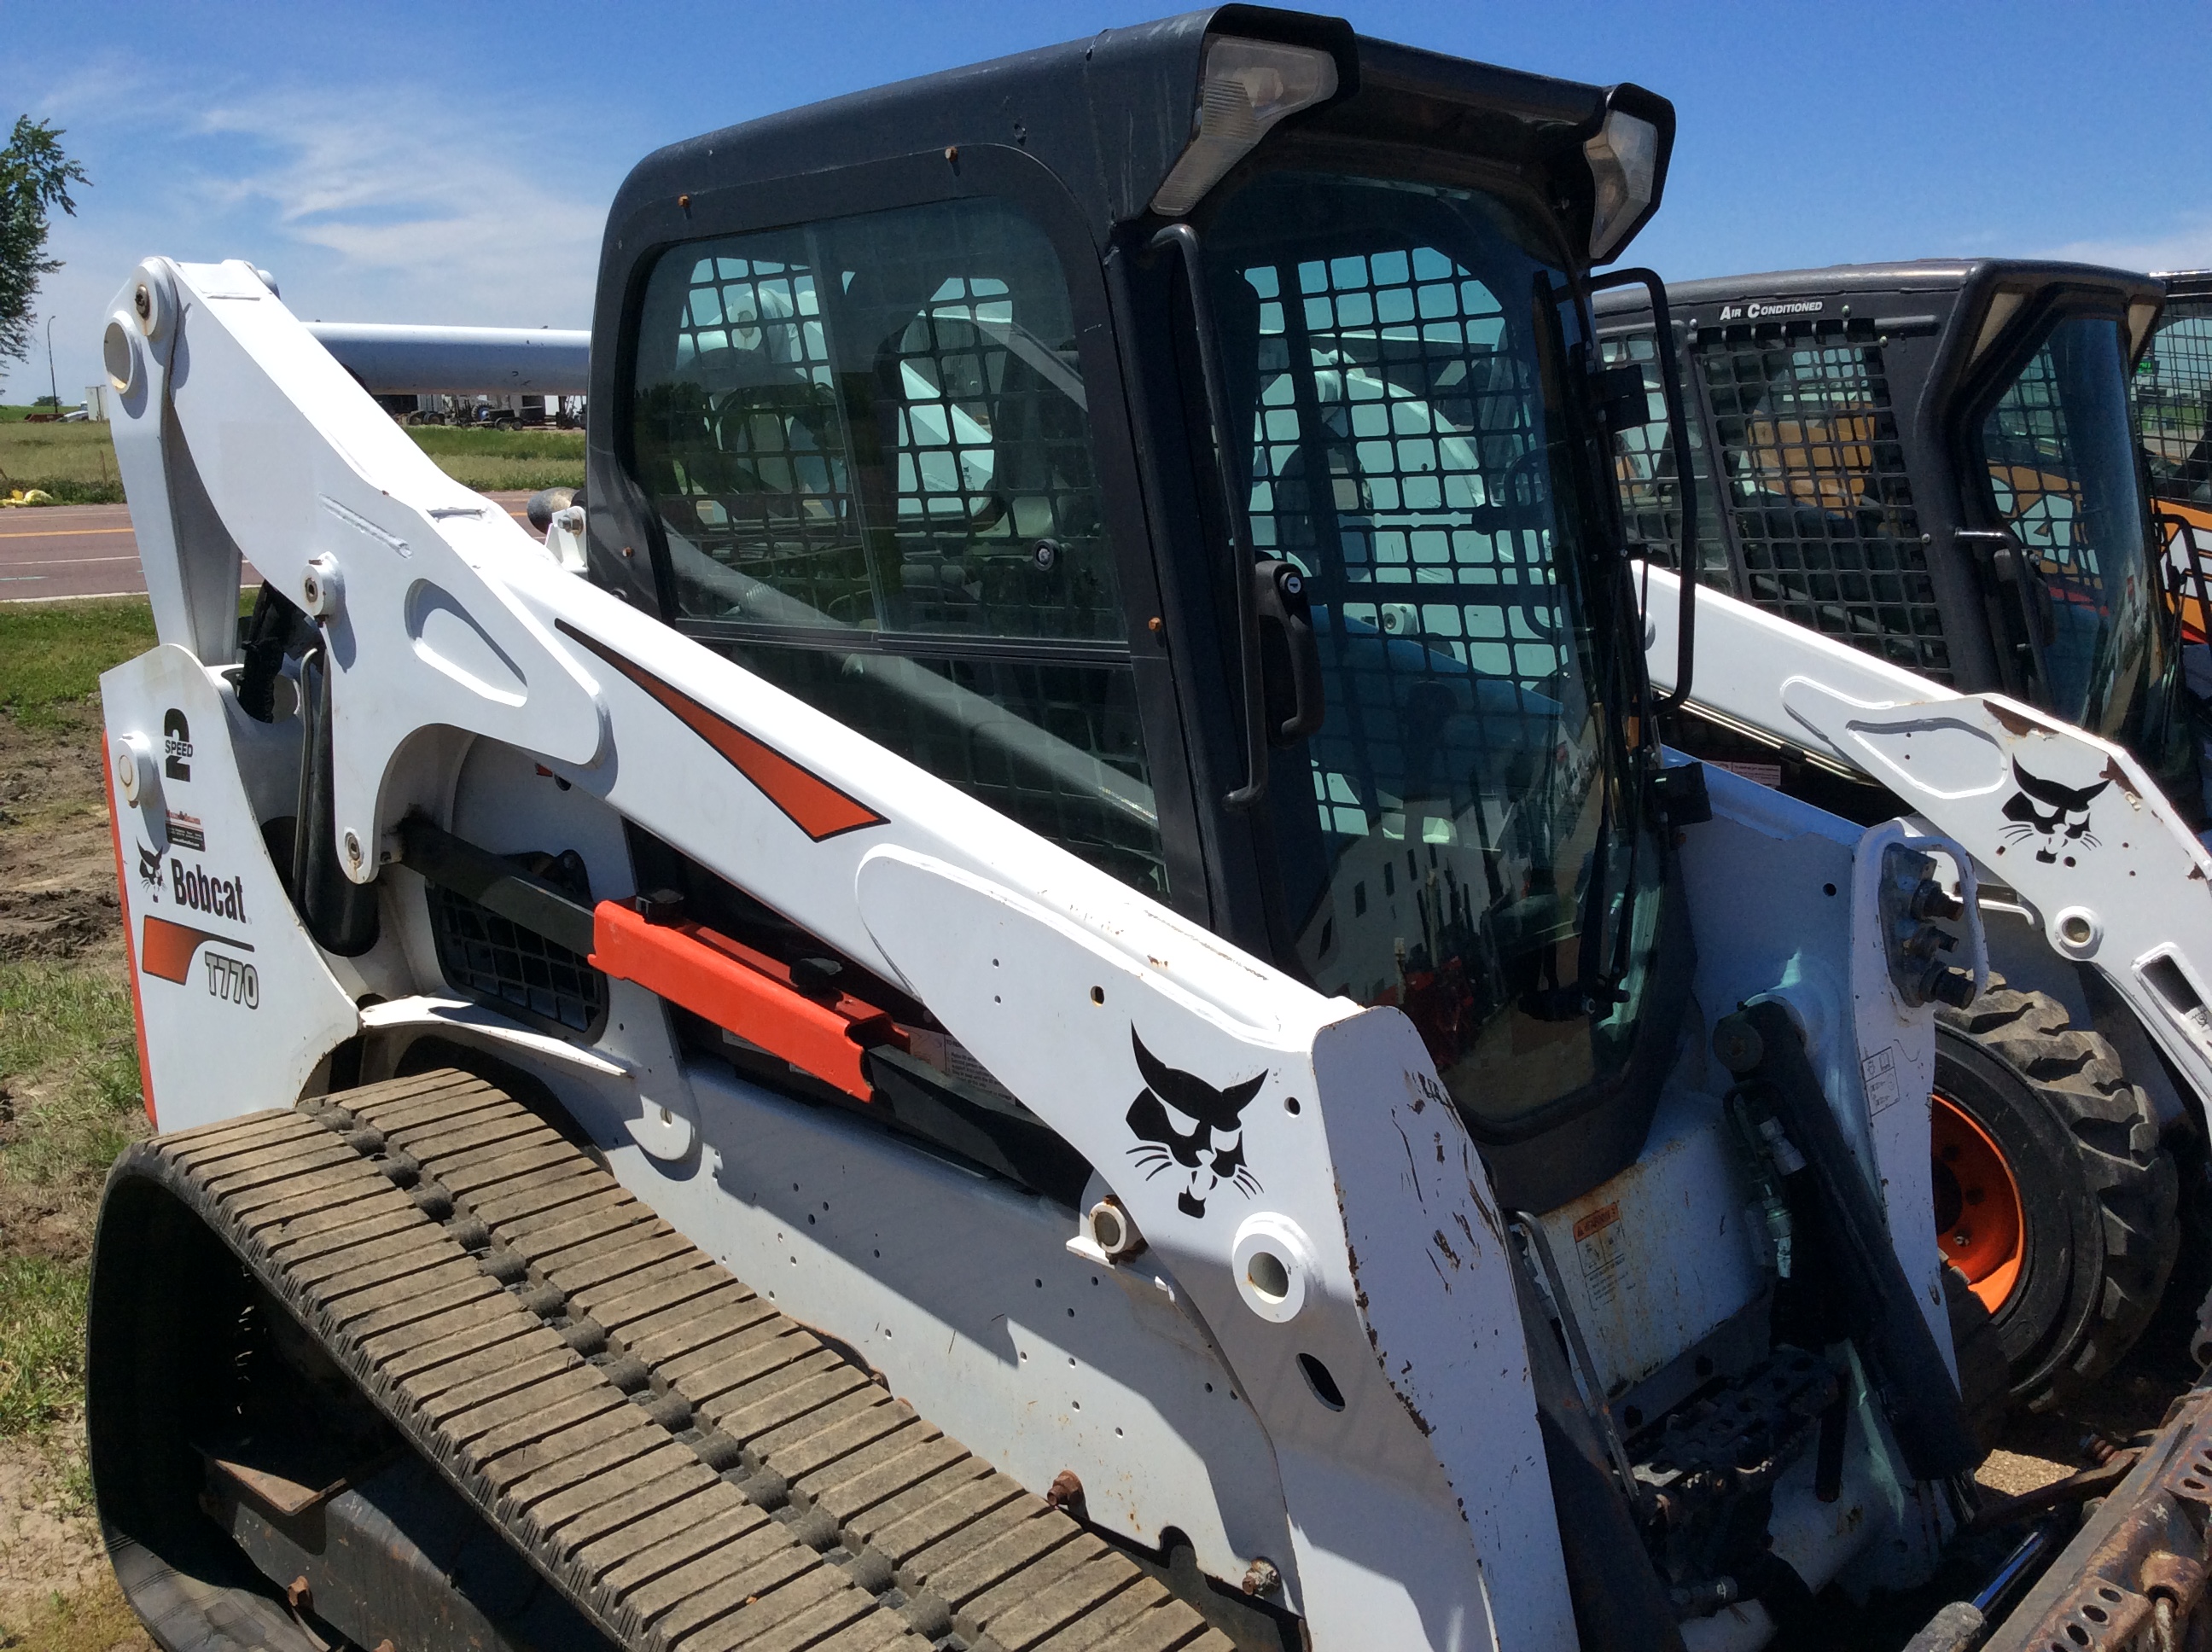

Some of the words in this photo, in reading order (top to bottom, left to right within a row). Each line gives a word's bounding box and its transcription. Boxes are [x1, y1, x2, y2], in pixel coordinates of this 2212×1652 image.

[1720, 306, 1742, 320] AIR
[1748, 301, 1823, 318] CONDITIONED
[165, 739, 193, 758] SPEED
[171, 858, 246, 923] Bobcat
[205, 951, 259, 1009] T770
